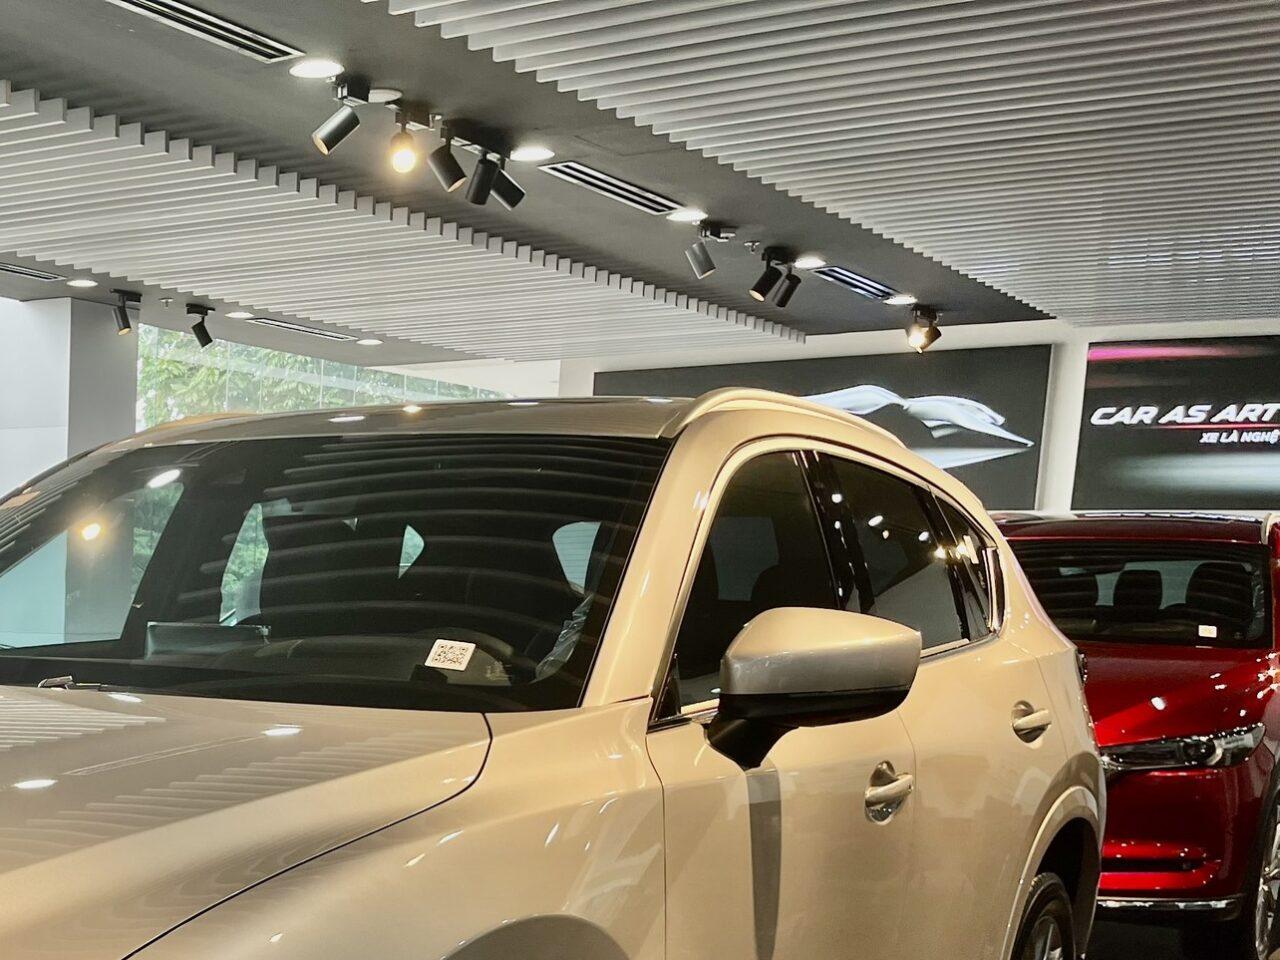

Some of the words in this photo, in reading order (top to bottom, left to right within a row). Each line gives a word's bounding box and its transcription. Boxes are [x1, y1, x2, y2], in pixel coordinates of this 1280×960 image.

[1090, 404, 1159, 426] CAR
[1157, 404, 1212, 425] AS
[1210, 403, 1280, 423] ART
[1199, 432, 1220, 444] XE
[1219, 429, 1239, 443] LÀ
